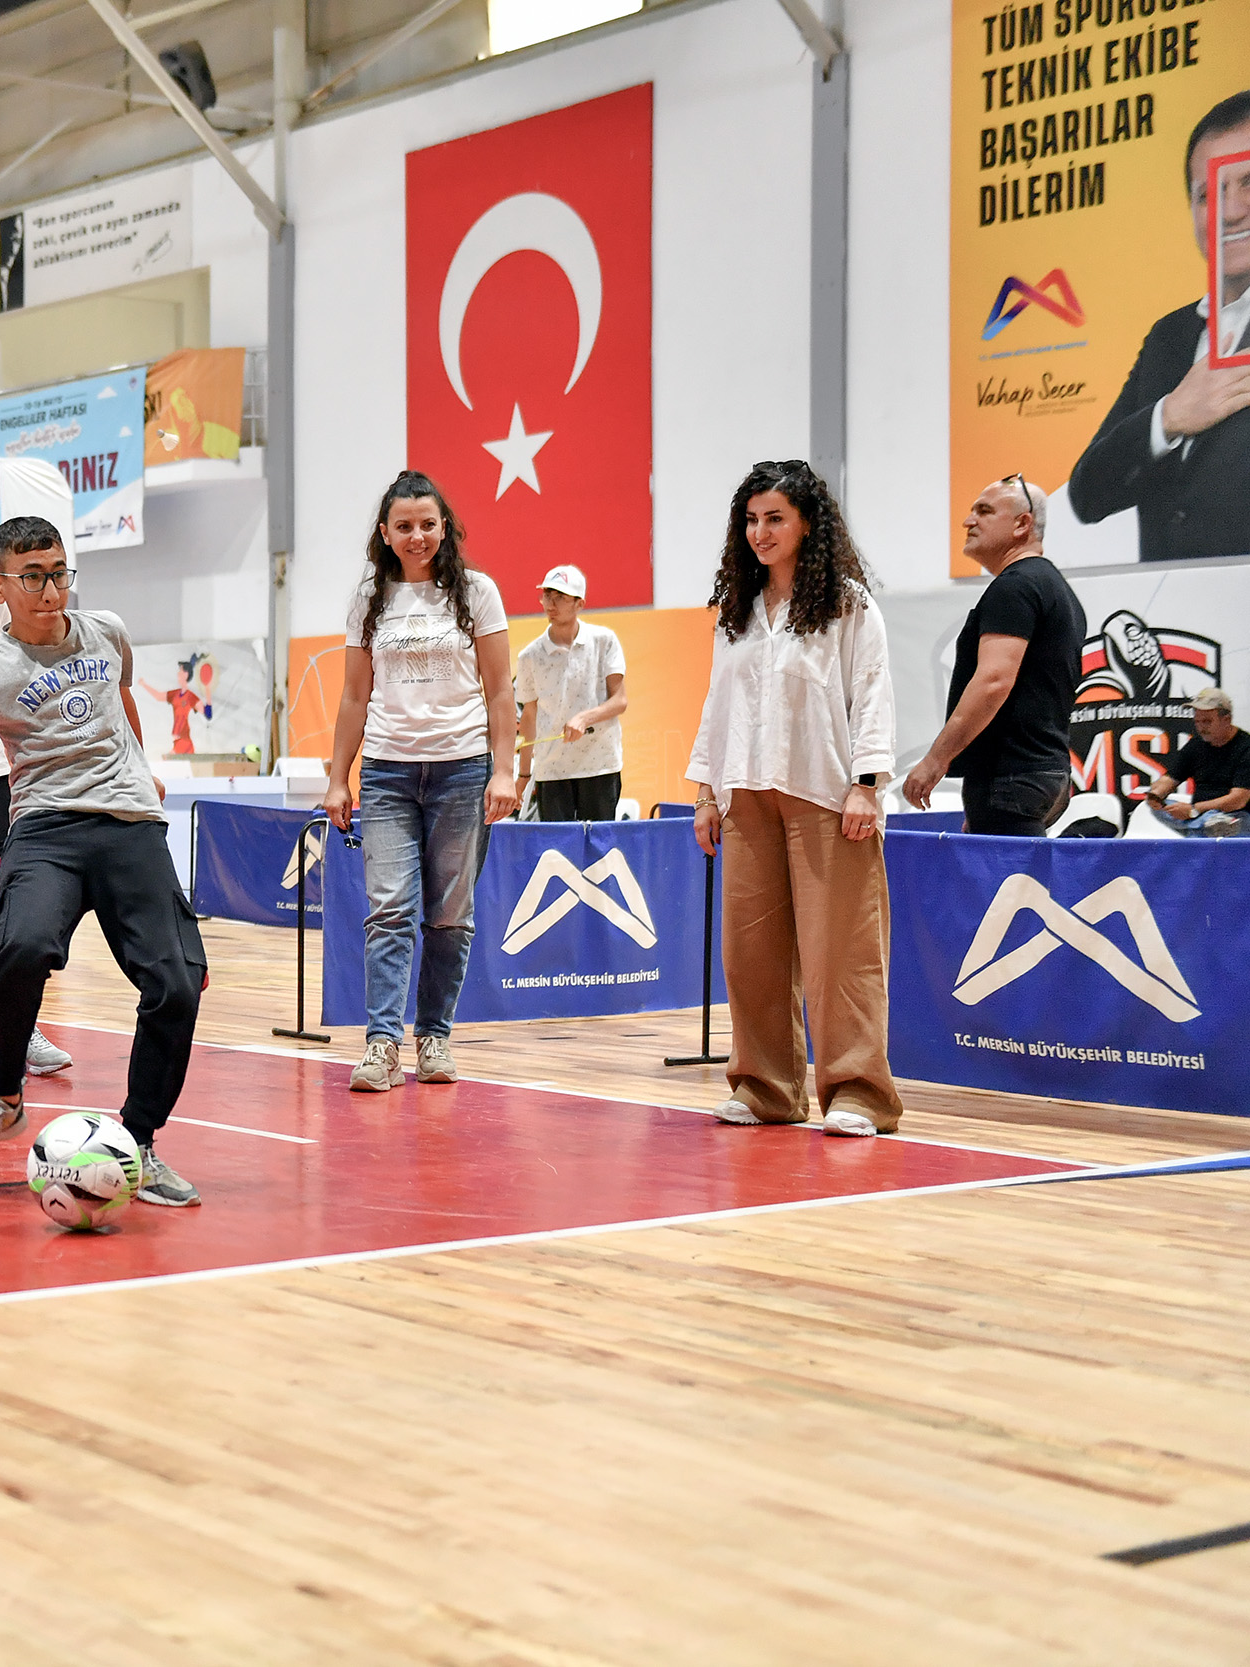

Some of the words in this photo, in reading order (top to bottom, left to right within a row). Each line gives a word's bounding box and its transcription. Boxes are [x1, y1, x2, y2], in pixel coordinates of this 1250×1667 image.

[982, 3, 1044, 56] TÜM
[983, 43, 1094, 112] TEKNİK
[1103, 20, 1200, 84] EKİBE
[979, 93, 1154, 171] BAŞARILAR
[59, 200, 114, 222] sporcunun
[132, 201, 181, 223] zamanda
[979, 161, 1105, 227] DİLERİM
[49, 403, 87, 421] HAFTASI
[977, 375, 1034, 416] Vahap
[58, 452, 119, 495] DİNİZ
[377, 629, 458, 650] Different
[17, 669, 62, 713] NEW
[60, 659, 110, 684] YORK
[1097, 702, 1163, 720] BÜYÜKŞEHİR
[501, 978, 515, 989] T.C.
[516, 974, 551, 988] MERSİN
[552, 971, 615, 988] BÜYÜKŞEHİR
[616, 967, 660, 984] BELEDİYESİ
[954, 1033, 975, 1048] T.C.
[977, 1036, 1026, 1055] MERSİN
[1028, 1041, 1123, 1064] BÜYÜKŞEHİR
[1126, 1050, 1206, 1070] BELEDİYESİ
